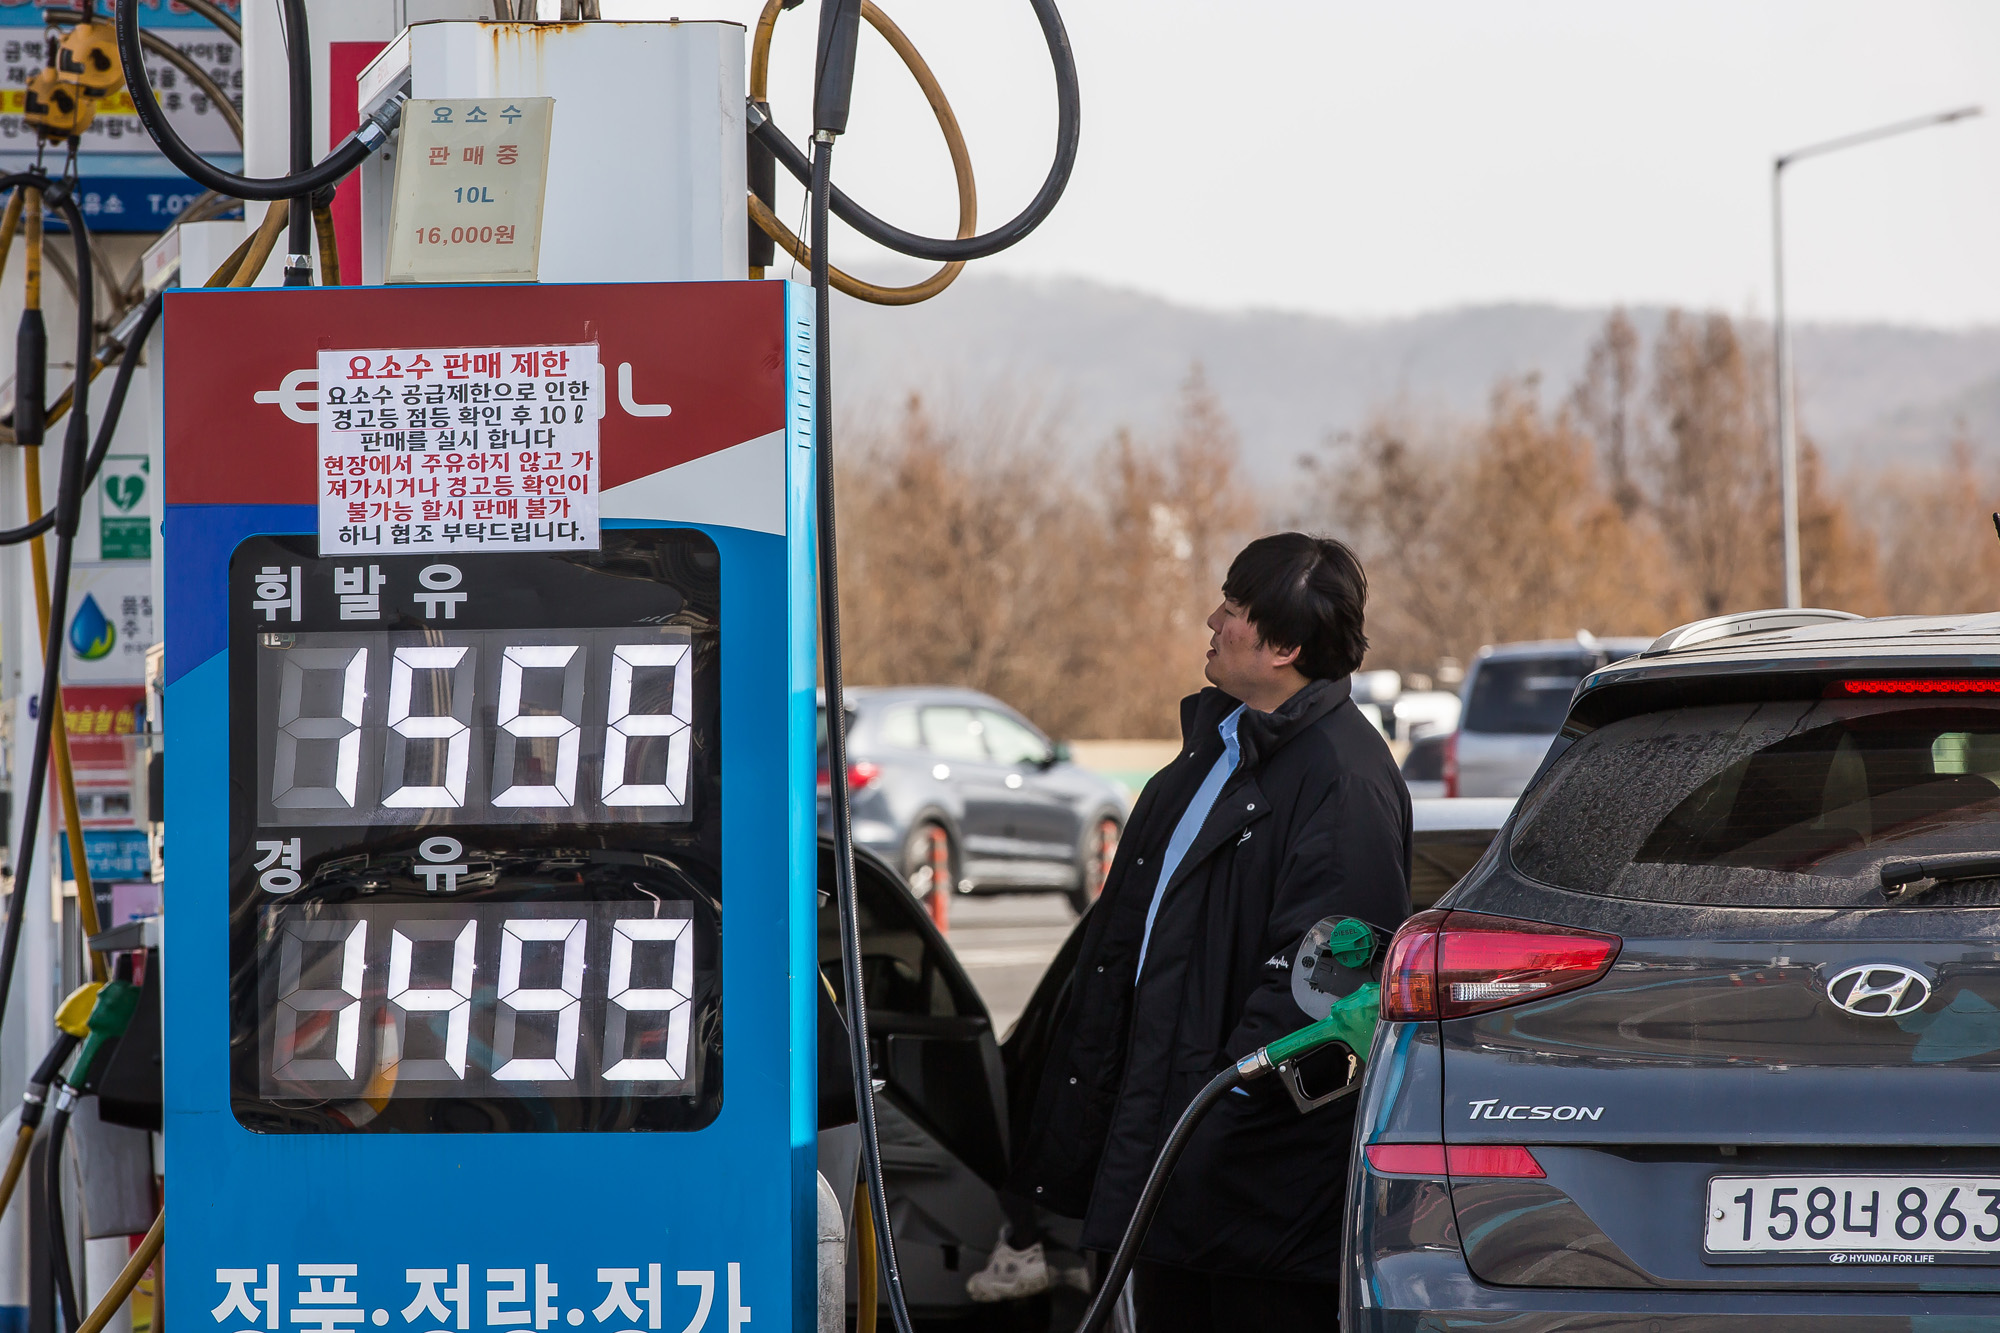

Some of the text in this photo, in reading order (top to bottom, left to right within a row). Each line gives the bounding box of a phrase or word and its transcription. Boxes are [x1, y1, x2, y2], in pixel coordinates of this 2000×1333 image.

[431, 104, 523, 124] 요소수
[454, 186, 494, 203] 10L
[415, 224, 516, 246] 16,000원
[346, 351, 569, 380] 요소수 판매 제한
[327, 381, 589, 405] 요소수 공급제한으로 인한
[332, 409, 398, 430] 경고등
[406, 407, 451, 428] 점등
[458, 406, 501, 426] 확인
[511, 405, 532, 425] 후
[540, 406, 566, 424] 10
[360, 428, 555, 452] 판매를 실시 합니다
[324, 451, 593, 476] 현장에서 주유하지 않고 가
[448, 476, 514, 497] 경고등
[522, 474, 587, 497] 확인이
[347, 498, 570, 522] 불가능 할시 판매 불가
[339, 521, 584, 545] 하니 협조 부탁드립니다.
[252, 563, 468, 622] 휘발유
[335, 644, 692, 808] 1558
[1333, 928, 1358, 937] DIESEL
[335, 919, 693, 1081] 1499
[1733, 1186, 1880, 1241] 158너
[1849, 1253, 1935, 1263] HYUNDAI FOR LIFE
